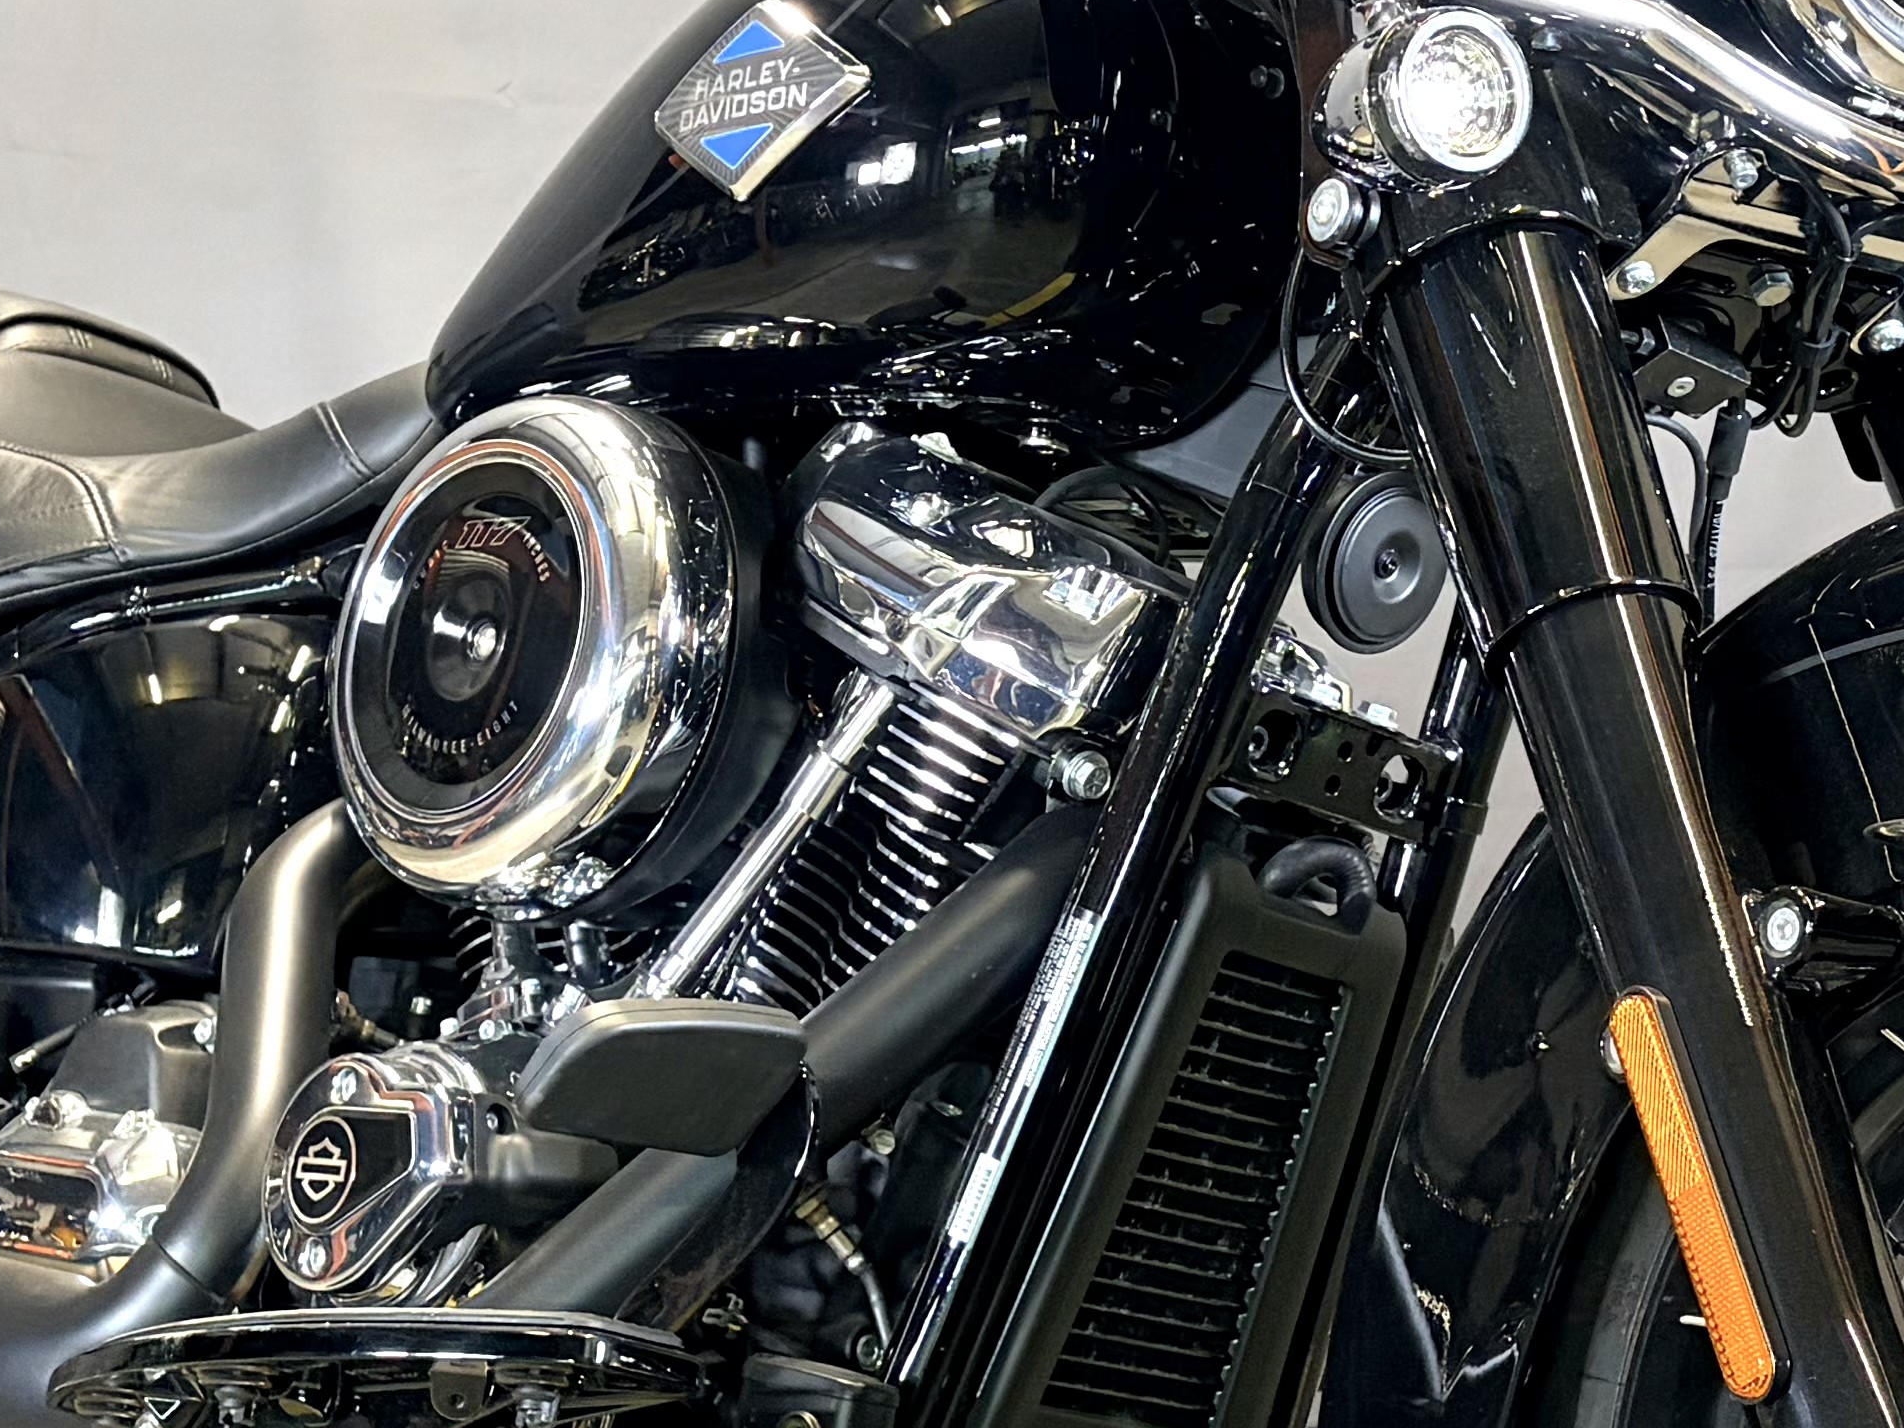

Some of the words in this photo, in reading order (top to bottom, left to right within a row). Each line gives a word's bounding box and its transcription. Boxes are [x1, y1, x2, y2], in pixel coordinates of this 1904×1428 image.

[694, 55, 802, 101] HARLEY-
[678, 82, 809, 133] DAVIDSON
[454, 515, 533, 550] 117
